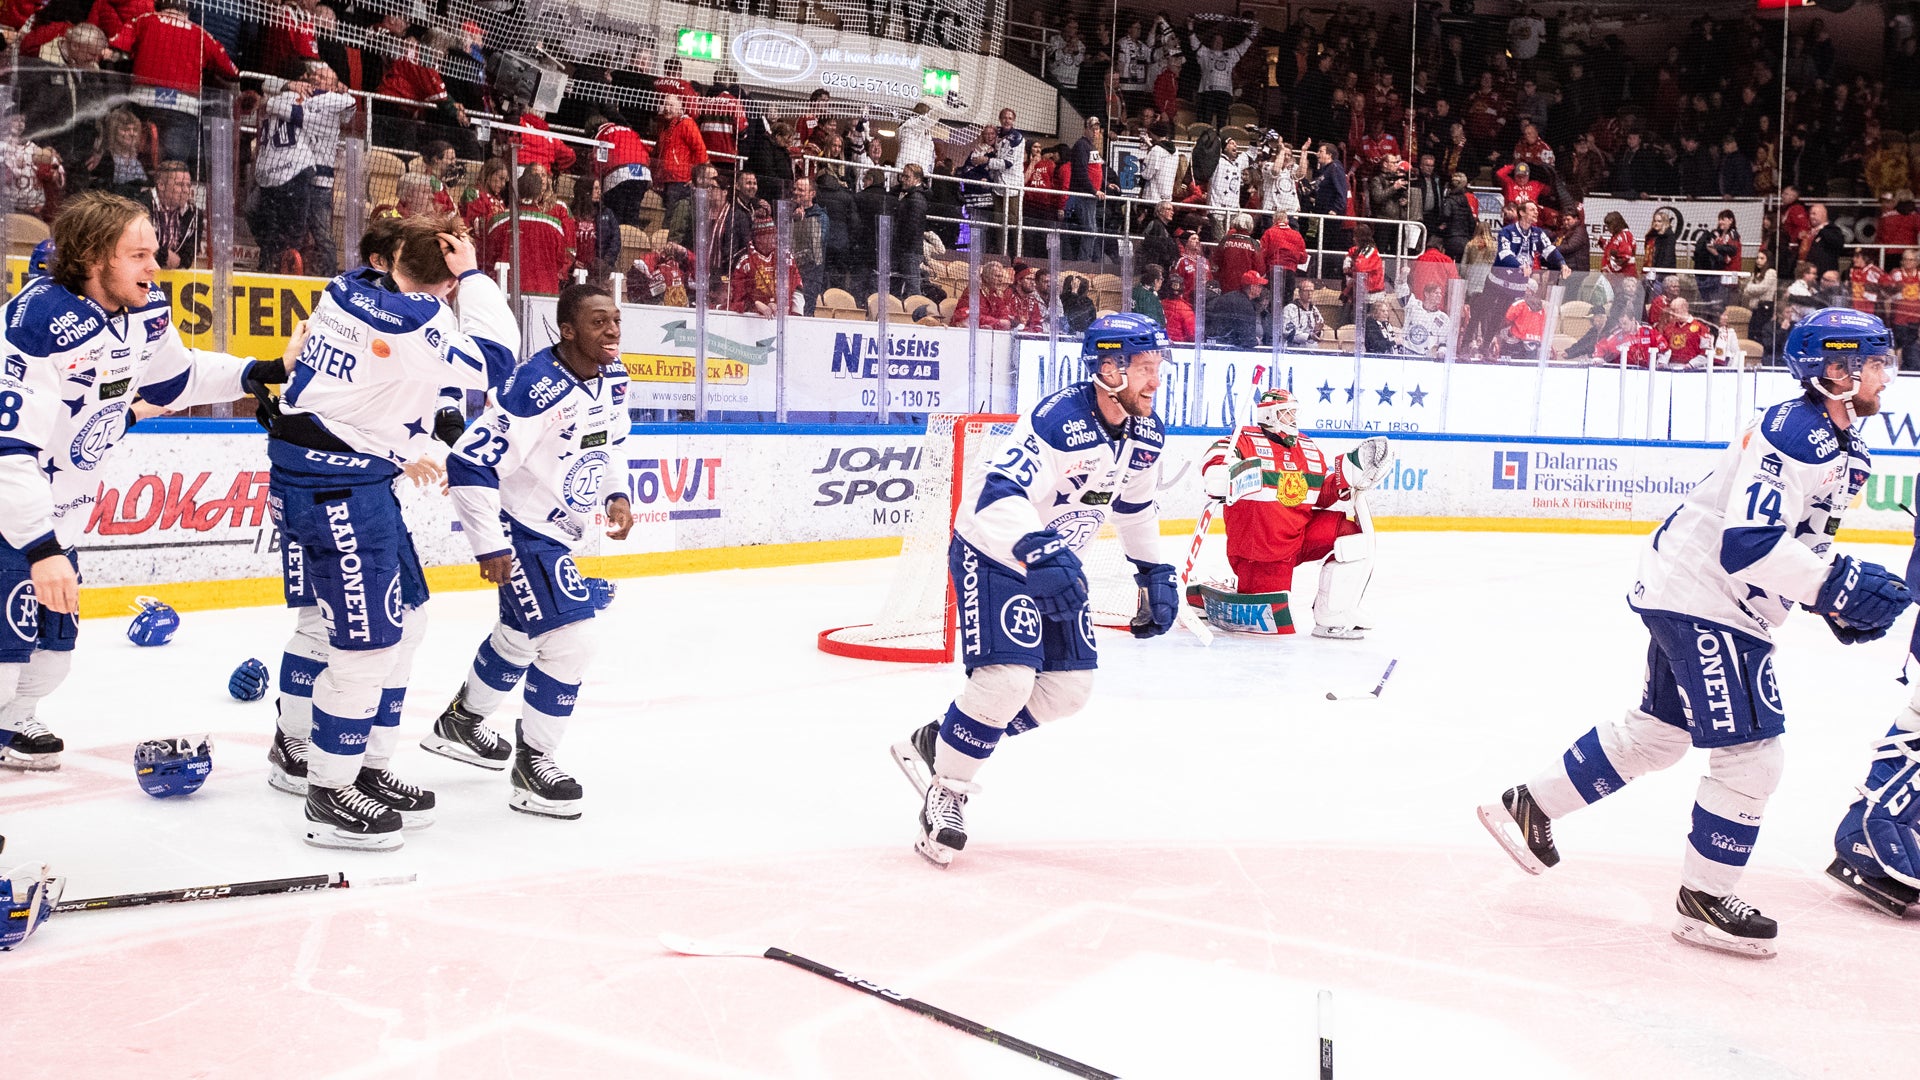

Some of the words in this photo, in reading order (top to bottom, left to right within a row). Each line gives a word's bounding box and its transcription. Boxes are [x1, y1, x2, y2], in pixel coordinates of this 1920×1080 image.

[50, 311, 79, 336] clas
[56, 316, 99, 347] ohlson
[1825, 341, 1858, 349] engcon
[301, 334, 357, 383] SÄTER
[724, 363, 744, 379] AB
[913, 365, 932, 378] AB
[529, 375, 553, 400] clas
[536, 378, 569, 409] ohlson
[902, 390, 924, 407] 130
[926, 390, 940, 407] 75
[0, 390, 23, 432] 8
[1062, 419, 1087, 434] clas
[463, 426, 509, 468] 23
[304, 448, 371, 469] CCM
[994, 447, 1039, 488] 25
[1535, 450, 1618, 471] Dalarnas
[813, 477, 915, 507] SPO
[1533, 473, 1698, 497] Försäkringsbolag
[1532, 496, 1560, 509] Bank
[1562, 497, 1570, 508] &
[1572, 497, 1632, 512] Försäkring
[1745, 481, 1782, 525] 14
[326, 502, 371, 642] RADONETT
[1694, 624, 1737, 734] ONETT
[953, 729, 965, 742] TAB
[965, 736, 981, 749] KARL
[333, 807, 357, 822] CCM
[1532, 824, 1540, 844] CCM
[1711, 837, 1729, 849] TAB
[184, 886, 232, 899] CCM
[1708, 906, 1730, 924] CCM
